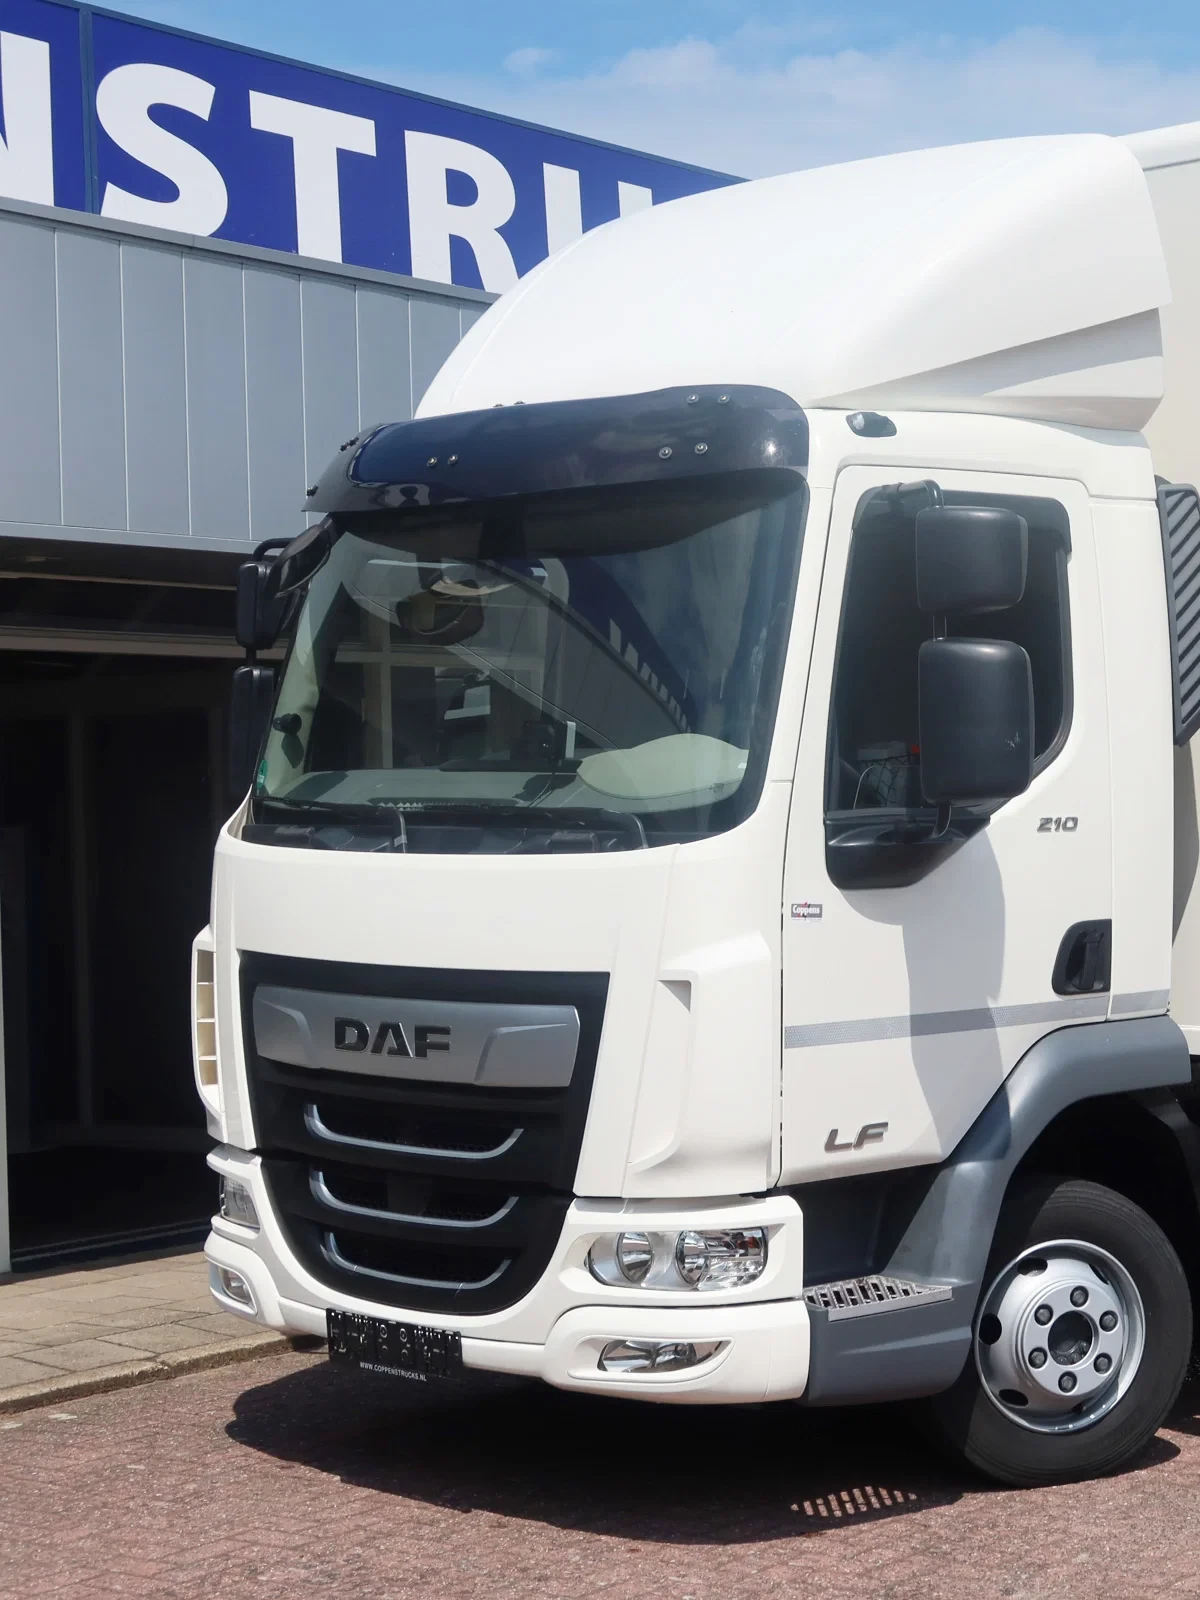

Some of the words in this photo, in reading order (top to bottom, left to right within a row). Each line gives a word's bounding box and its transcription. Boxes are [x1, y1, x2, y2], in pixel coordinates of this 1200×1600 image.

[1036, 816, 1079, 833] 210
[792, 904, 821, 917] Coppens
[334, 1016, 451, 1060] DAF
[824, 1121, 889, 1153] LF
[359, 1361, 428, 1382] WWW.COPPENSTRUCKS.NL
